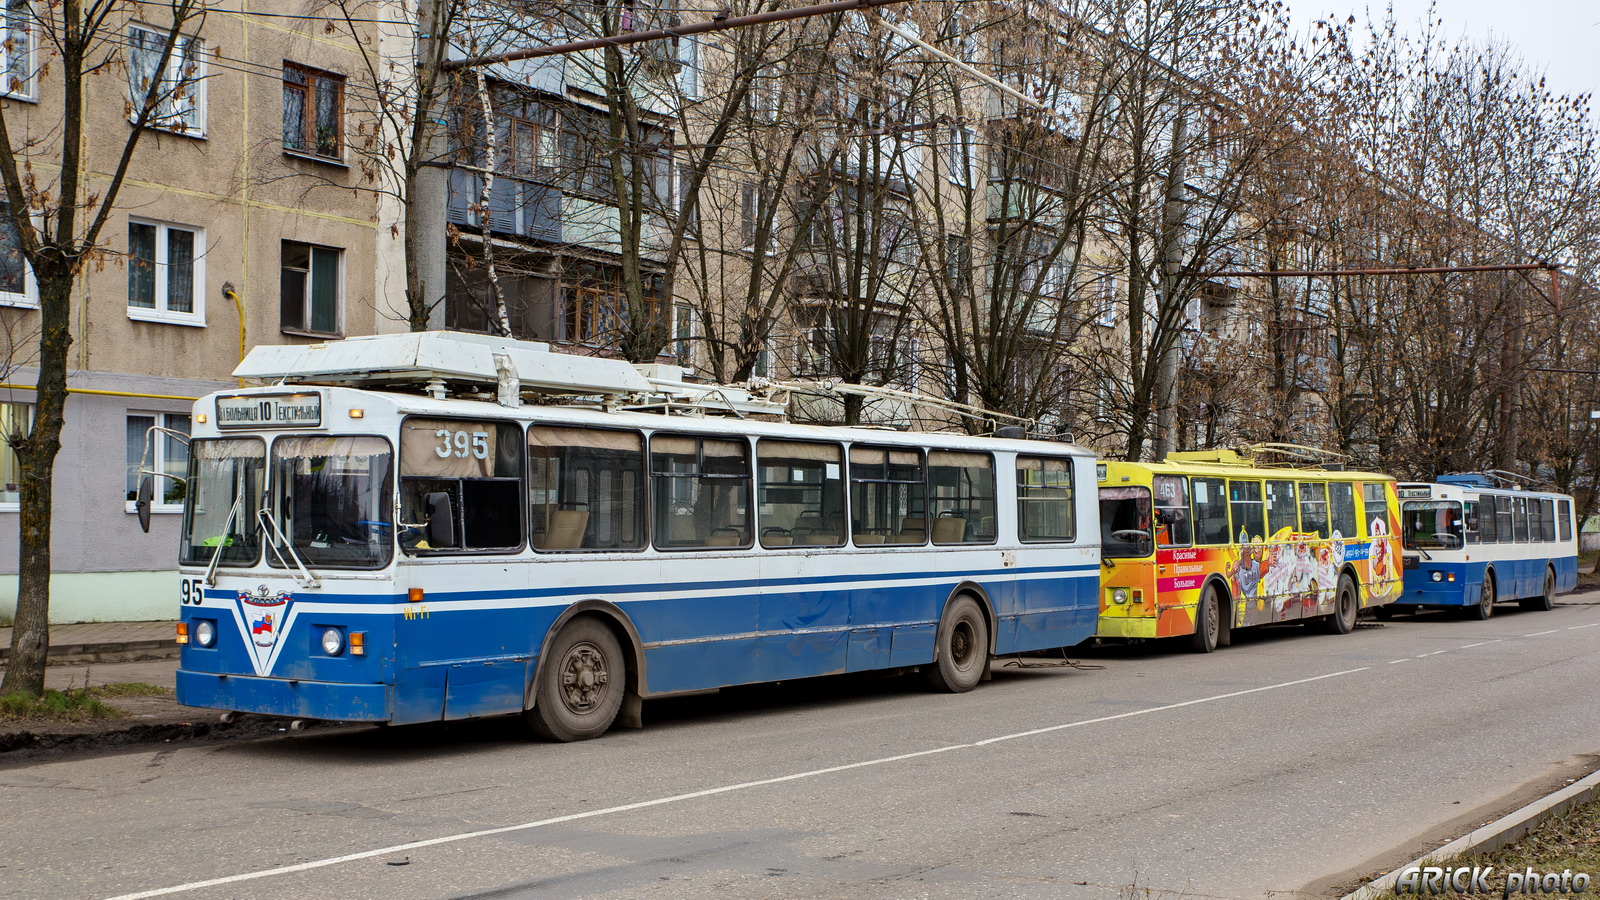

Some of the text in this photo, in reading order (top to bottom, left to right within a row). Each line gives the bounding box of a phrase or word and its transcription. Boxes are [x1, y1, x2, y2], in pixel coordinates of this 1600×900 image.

[259, 401, 272, 421] 10
[435, 429, 489, 460] 395
[1160, 483, 1175, 498] 463
[1173, 551, 1197, 563] Красивые
[1174, 563, 1204, 576] Правильные
[1174, 578, 1196, 589] Большие
[403, 605, 430, 621] Wi-Fi
